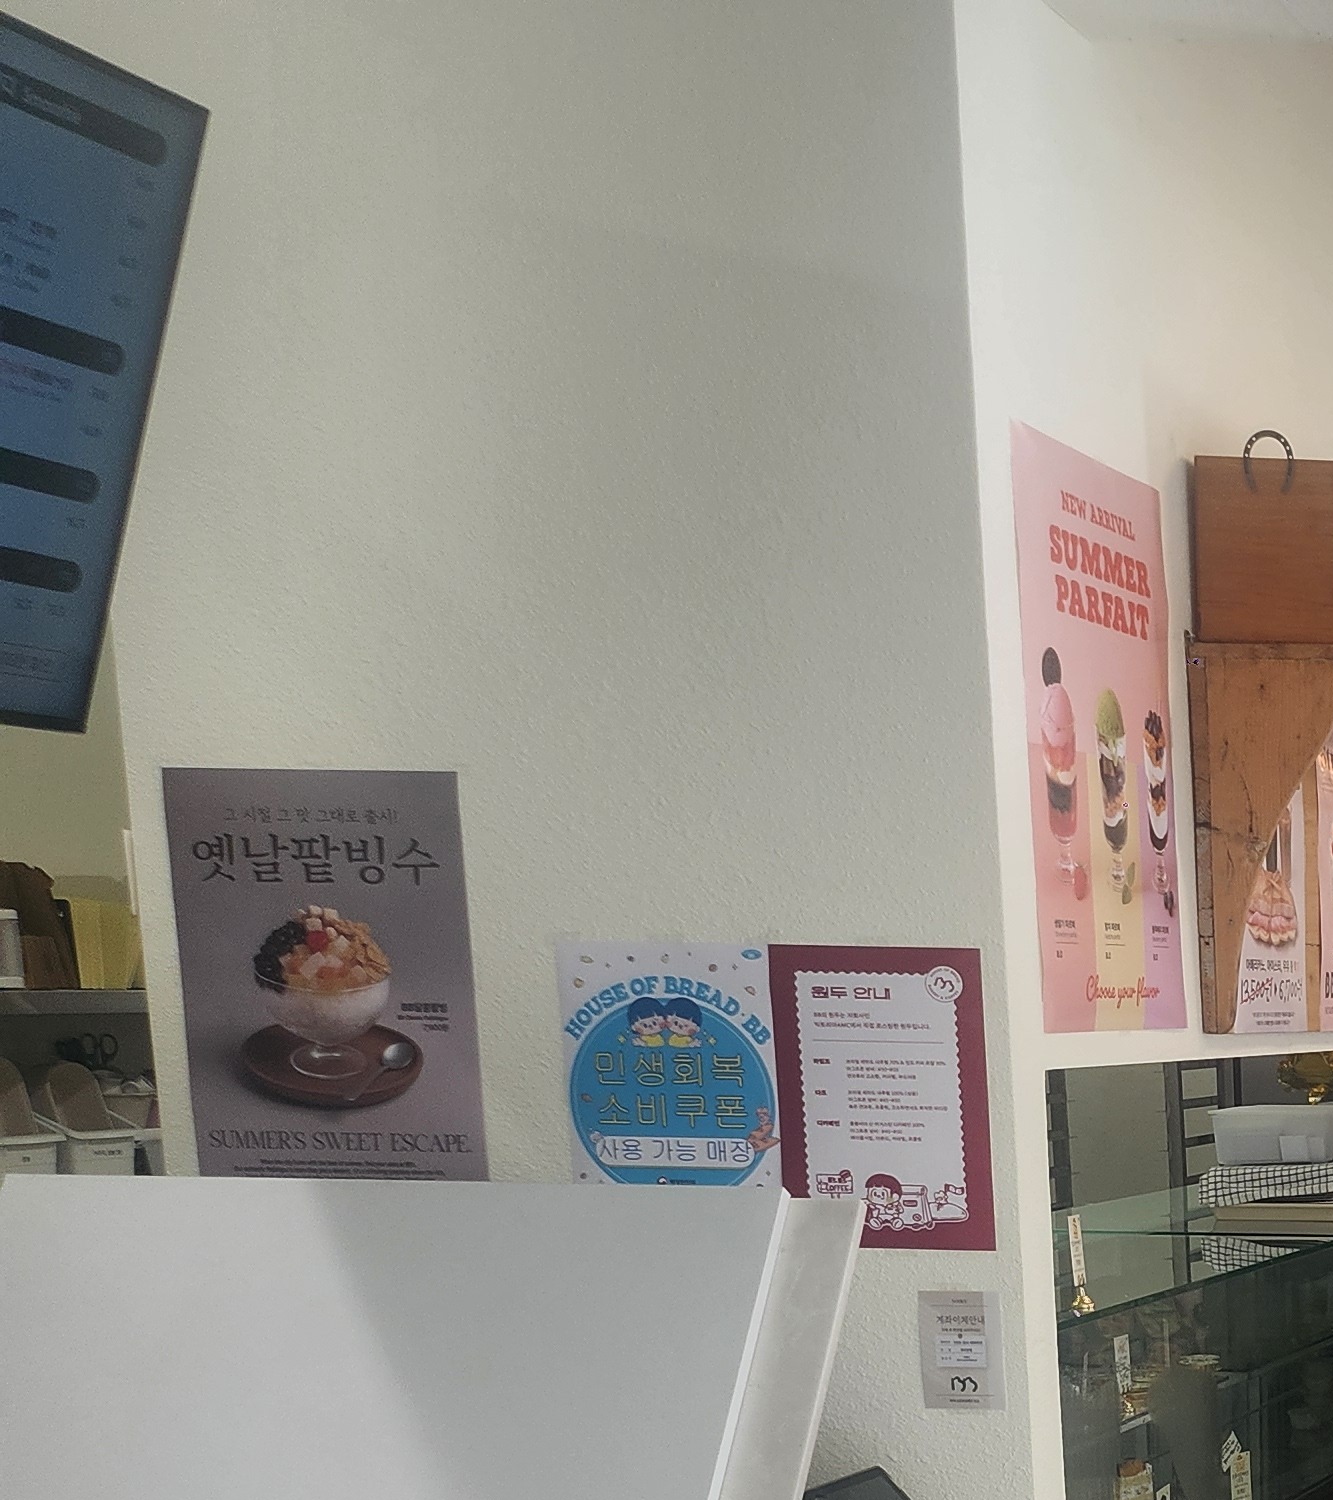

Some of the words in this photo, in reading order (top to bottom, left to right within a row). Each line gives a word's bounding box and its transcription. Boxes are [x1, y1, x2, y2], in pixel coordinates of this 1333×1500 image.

[1061, 490, 1087, 521] NEW
[1090, 503, 1135, 541] ARRIVAL
[1049, 523, 1151, 599] SUMMER
[1055, 574, 1150, 641] PARFAIT
[191, 832, 441, 886] 옛날팥빙수
[564, 982, 630, 1041] HOUSE
[629, 976, 660, 995] OF
[663, 975, 741, 1017] BREAD
[811, 985, 848, 999] 원두
[853, 987, 891, 1000] 안내
[1086, 975, 1116, 1003] Choose
[1117, 987, 1136, 1009] your
[1136, 976, 1161, 1007] flavor
[594, 1051, 746, 1088] 민생회복
[599, 1093, 749, 1129] 소비쿠폰
[208, 1129, 306, 1150] SUMMER'S
[312, 1131, 383, 1152] SWEET
[599, 1138, 644, 1162] 사용
[651, 1139, 698, 1162] 가능
[706, 1139, 753, 1164] 매장
[936, 1314, 985, 1326] 계좌이체안내
